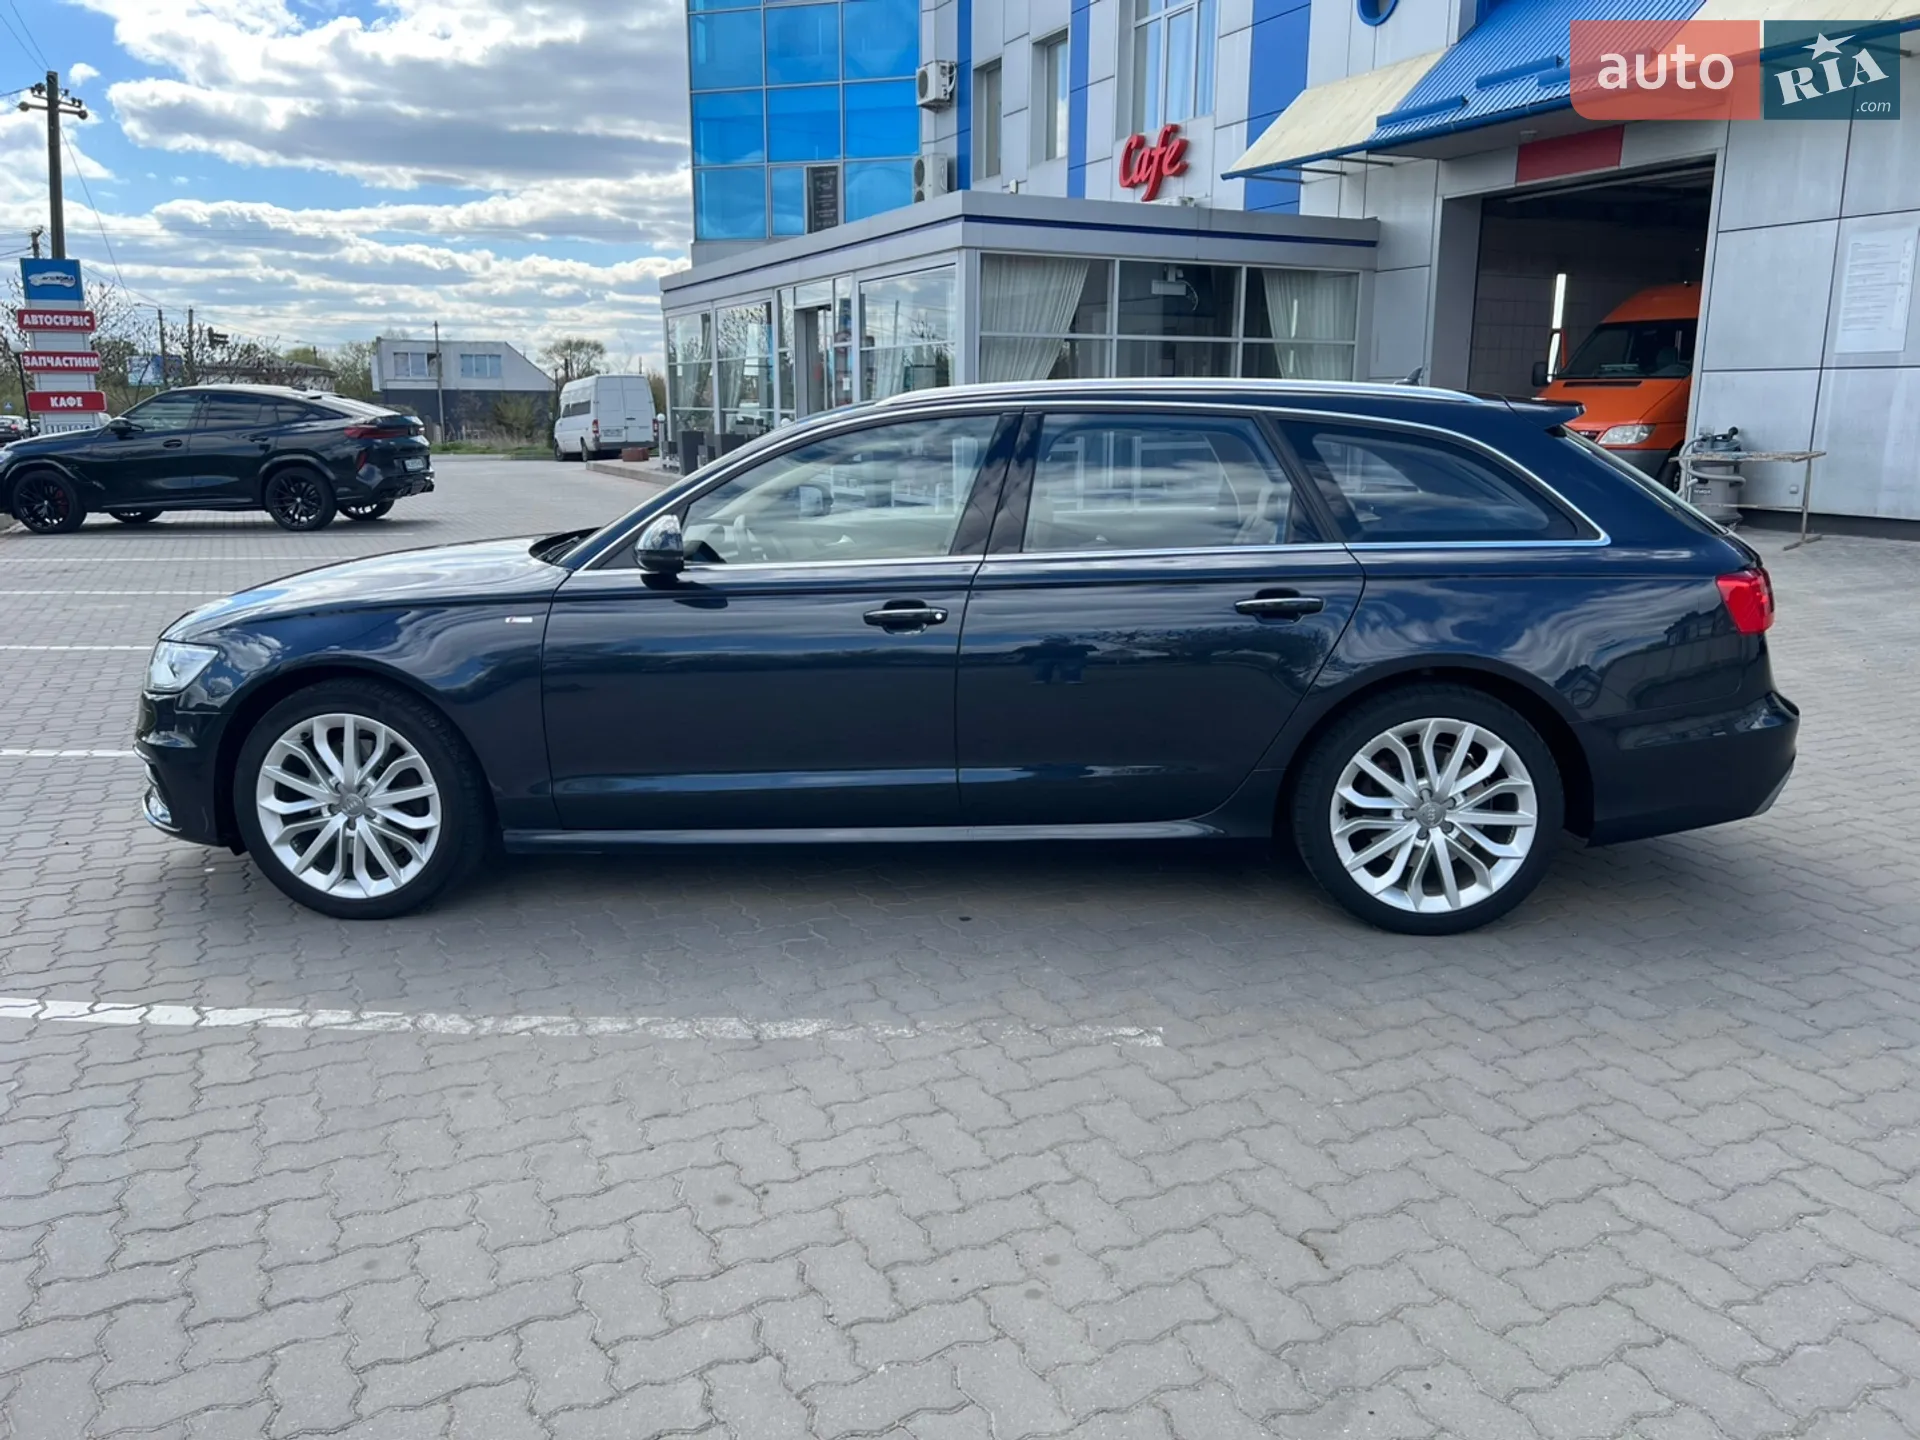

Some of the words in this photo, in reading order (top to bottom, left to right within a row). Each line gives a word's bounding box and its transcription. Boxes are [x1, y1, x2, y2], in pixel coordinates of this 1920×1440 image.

[1119, 123, 1189, 202] Cafe
[22, 313, 91, 327] АВТОСЕРВІС
[23, 355, 99, 368] ЗАПЧАСТИНИ
[49, 395, 83, 408] КАФЕ
